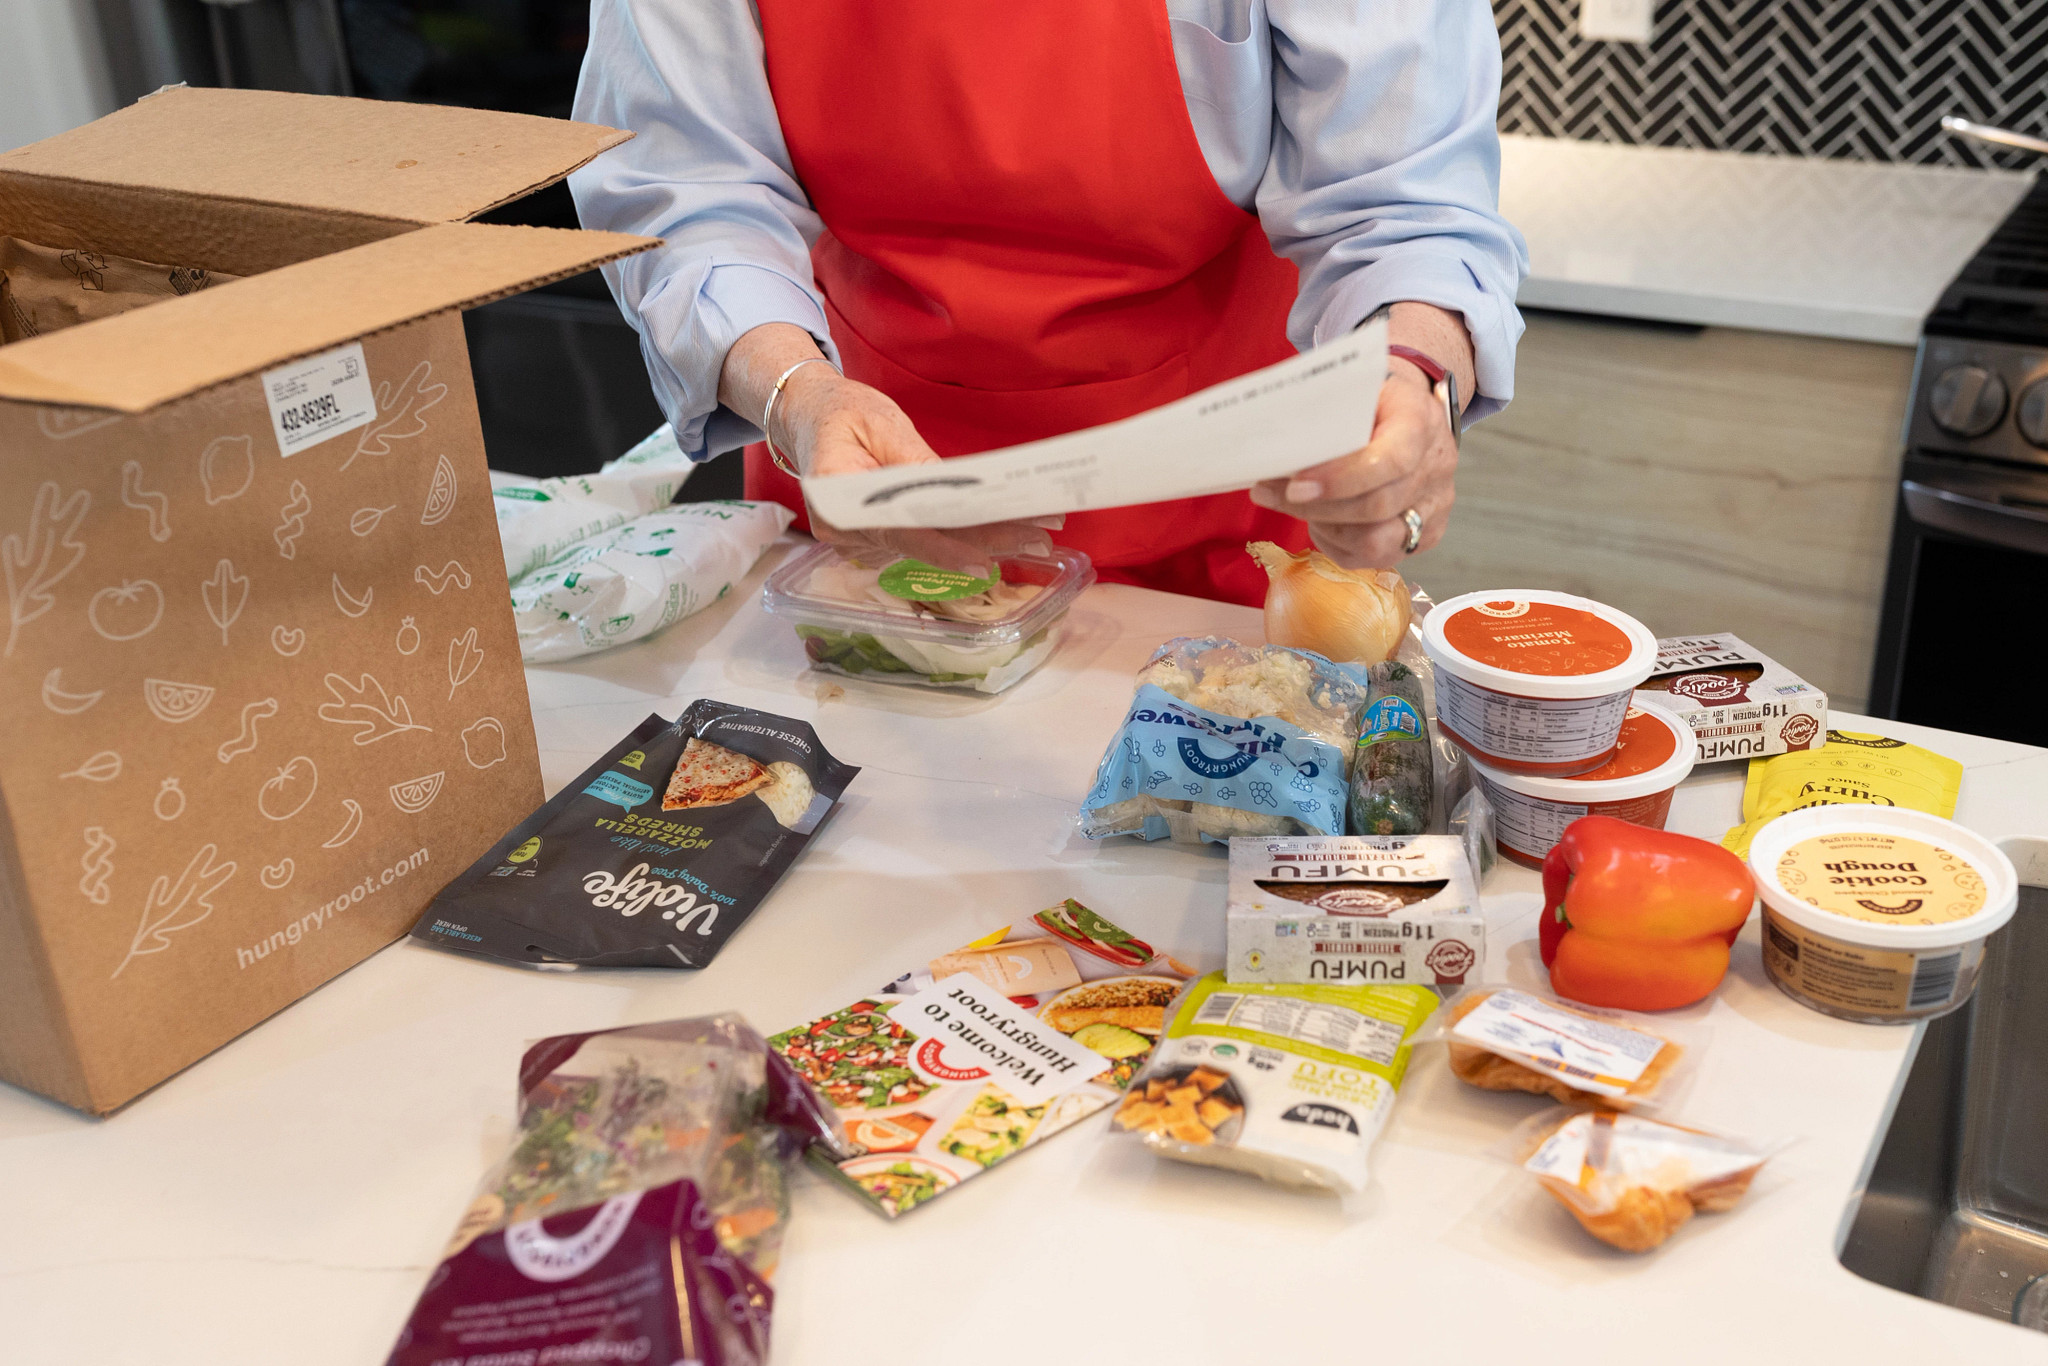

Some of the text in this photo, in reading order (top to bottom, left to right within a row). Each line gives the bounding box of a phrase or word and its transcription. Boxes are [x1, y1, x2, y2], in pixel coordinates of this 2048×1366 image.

[1492, 630, 1573, 643] Marinara
[1507, 635, 1575, 649] Tomato
[1672, 677, 1745, 695] Foodies
[1733, 703, 1788, 721] 11g PROTEIN
[718, 721, 777, 737] ALTERNATIVE
[776, 731, 812, 754] CHEESE
[1183, 741, 1252, 774] HUNGRYROOT
[1826, 776, 1871, 789] Sauce
[1798, 781, 1895, 807] Curry
[595, 817, 713, 849] MOZZARELLA
[626, 813, 704, 838] SHREDS
[609, 834, 643, 851] like
[1823, 860, 1918, 874] Dough
[651, 866, 738, 906] 100% Dairy Free
[1829, 875, 1928, 888] Cookie
[236, 847, 430, 970] hungryroot.com
[582, 862, 720, 936] Violife
[430, 925, 445, 933] BAG
[435, 919, 468, 932] OPEN HERE
[1402, 922, 1435, 940] 11g
[1309, 960, 1406, 979] PUMFU
[948, 987, 1078, 1074] Hungryroot
[924, 1003, 1045, 1087] Welcome to
[923, 1042, 980, 1079] HUNGRYROOT
[1295, 1062, 1379, 1090] TOFU
